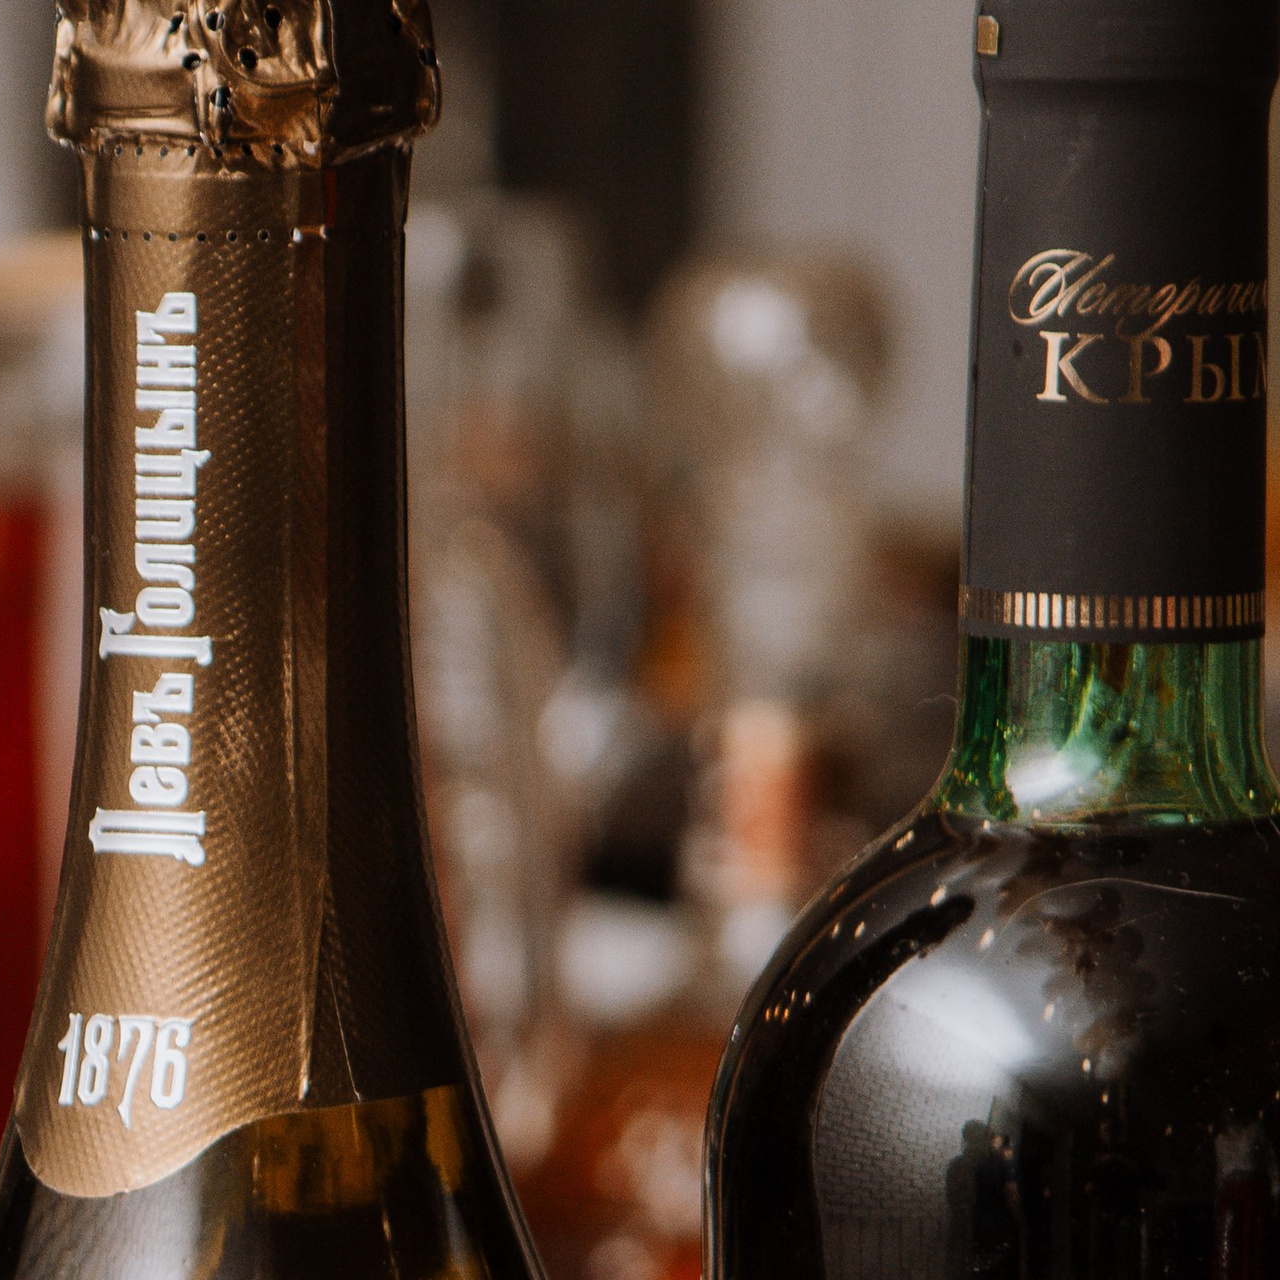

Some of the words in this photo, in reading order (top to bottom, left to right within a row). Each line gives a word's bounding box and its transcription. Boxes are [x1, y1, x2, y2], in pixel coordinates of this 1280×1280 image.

[99, 290, 212, 667] Голицынъ
[89, 669, 208, 867] Левъ
[58, 1011, 192, 1128] 1876
